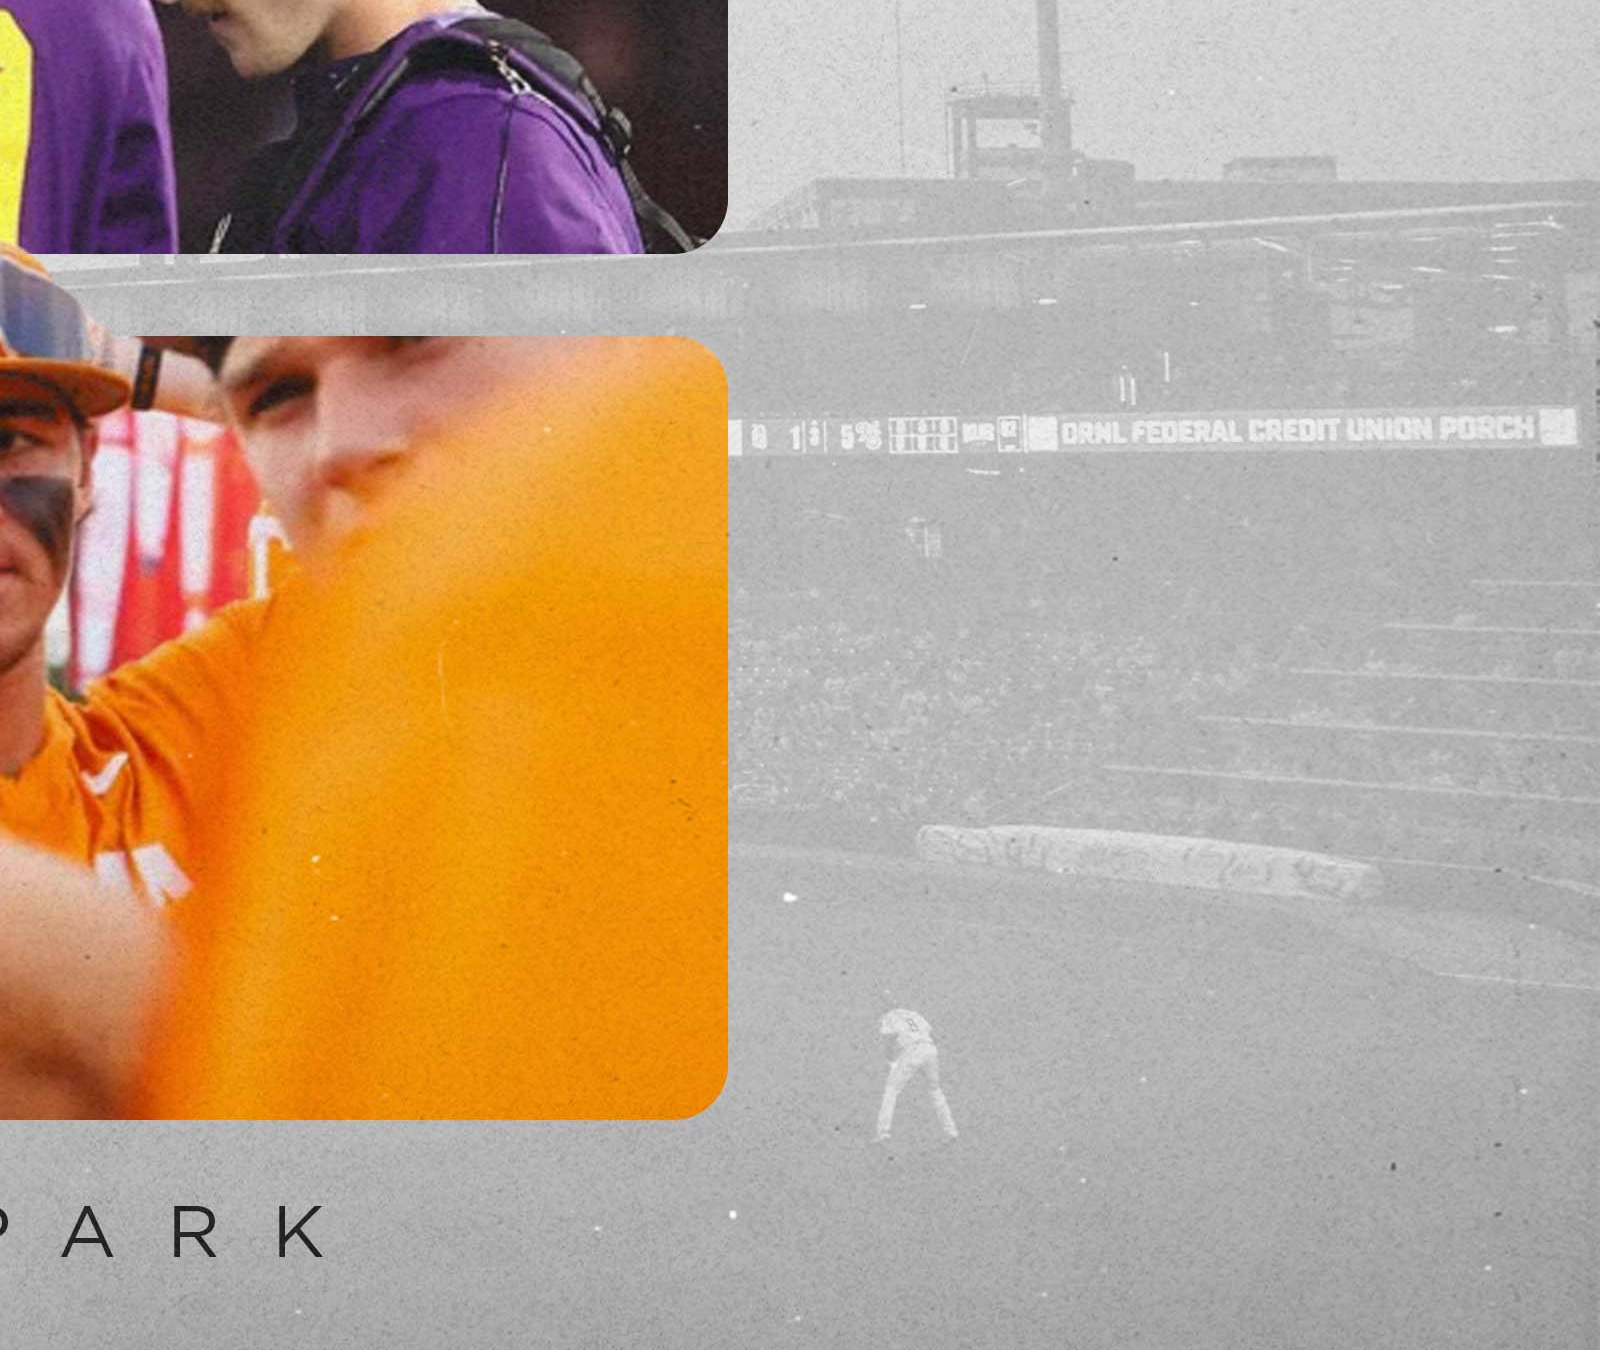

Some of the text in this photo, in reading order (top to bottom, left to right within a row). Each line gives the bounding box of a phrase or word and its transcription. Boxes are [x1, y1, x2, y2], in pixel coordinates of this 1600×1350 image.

[1132, 418, 1243, 444] FEDERAL
[1248, 417, 1341, 443] CREDIT
[1346, 415, 1433, 441] UNION
[1440, 413, 1536, 440] PORCH
